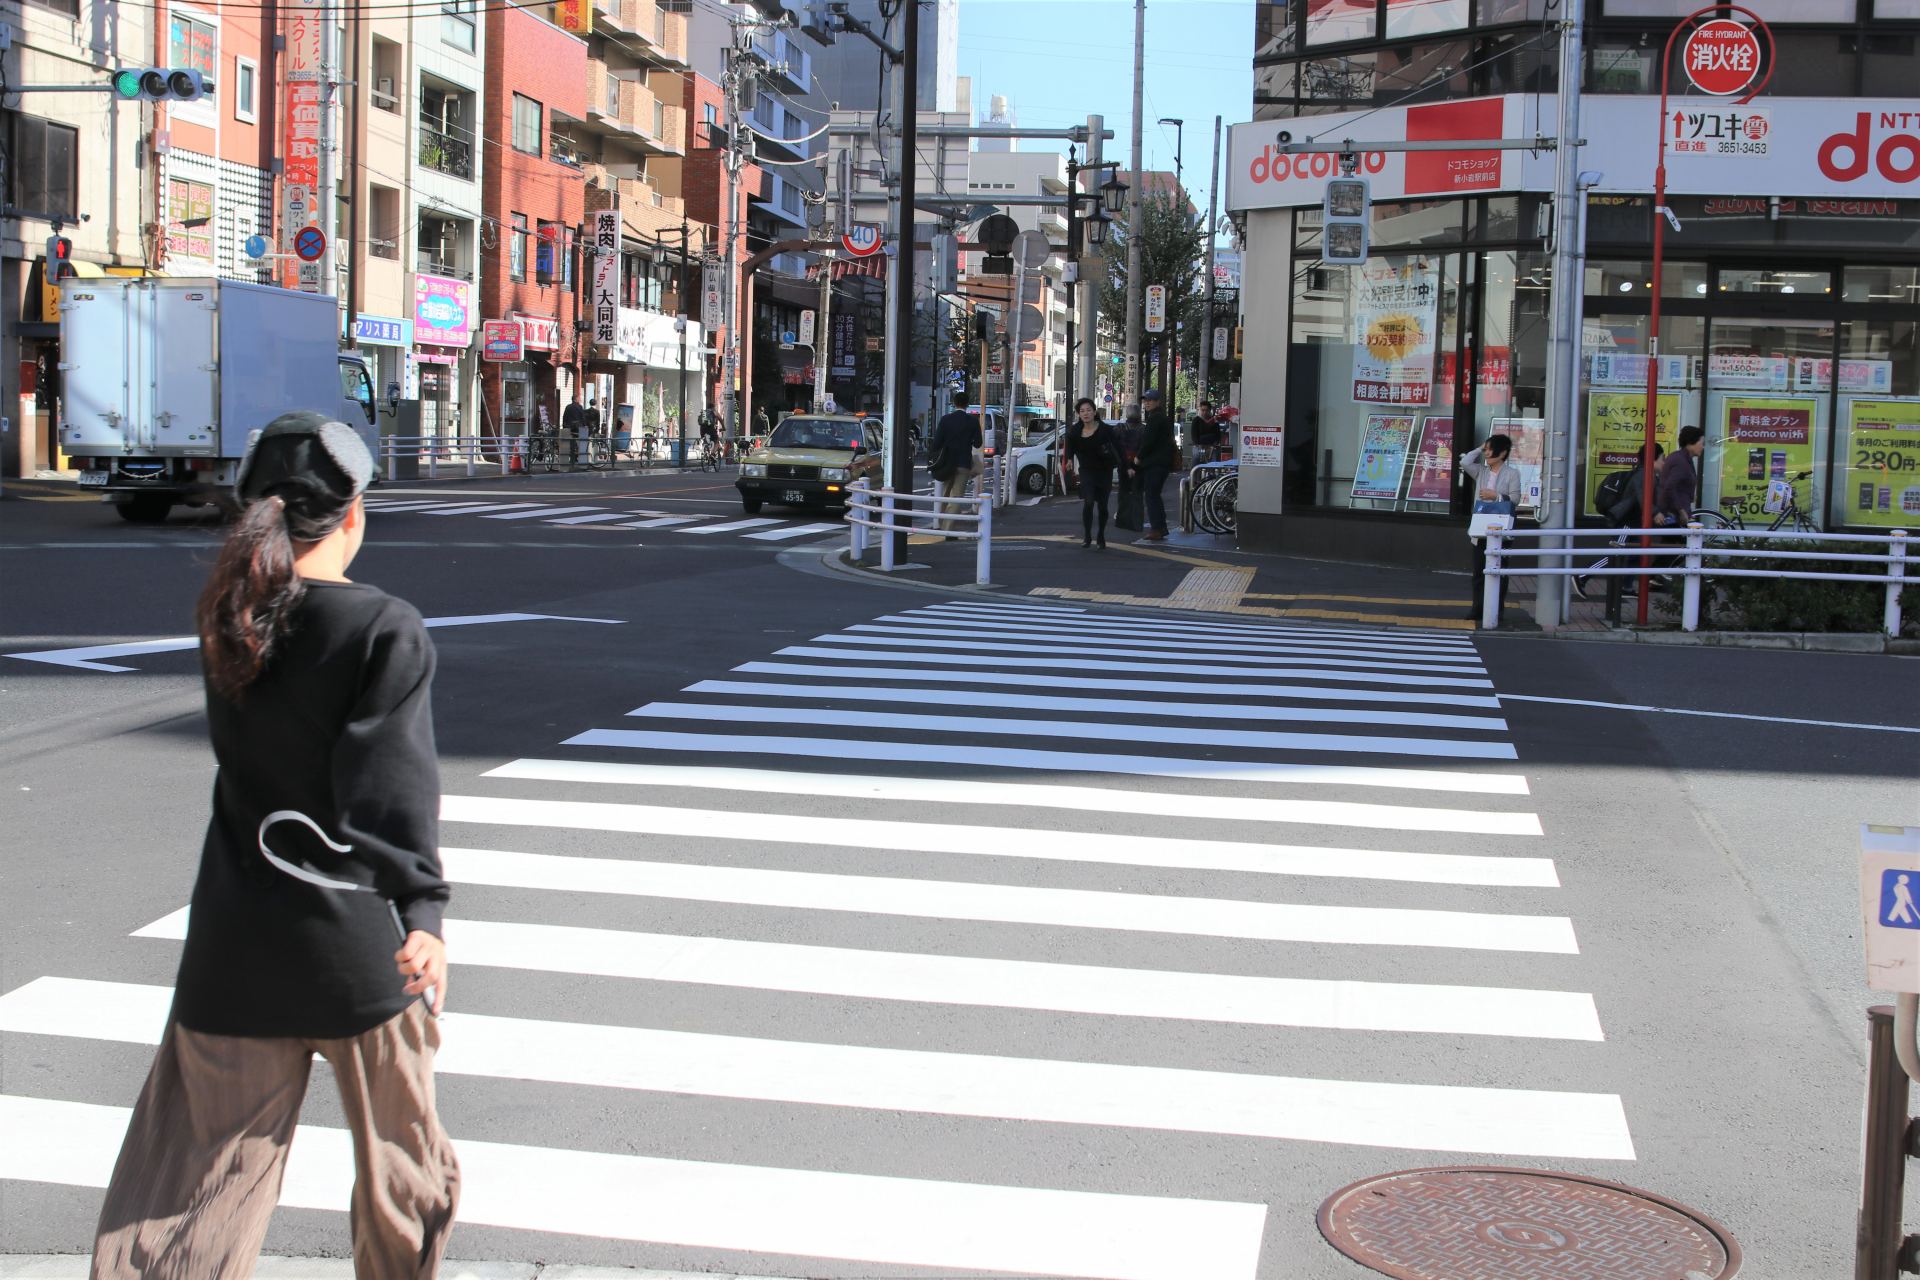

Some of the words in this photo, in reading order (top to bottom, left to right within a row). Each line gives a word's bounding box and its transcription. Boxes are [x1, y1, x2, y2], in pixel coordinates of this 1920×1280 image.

[293, 15, 306, 69] スクール
[1698, 30, 1714, 39] FIRE
[1715, 30, 1747, 39] HYDRANT
[1691, 43, 1753, 71] 消火栓
[291, 86, 319, 159] 高価買取
[1675, 141, 1707, 152] 直進
[1447, 157, 1499, 171] ドコモショップ
[598, 214, 615, 249] 焼肉
[852, 226, 874, 245] 40
[597, 289, 615, 342] 大同苑
[356, 320, 400, 341] アリス薬局
[1356, 383, 1429, 401] 相談会開催中!
[1603, 421, 1667, 433] ドコモの金
[1739, 415, 1800, 427] 新料金プラン
[1251, 436, 1280, 447] 駐輪禁止
[1733, 428, 1777, 439] docomo
[1779, 429, 1804, 439] with
[1605, 454, 1639, 463] docomo
